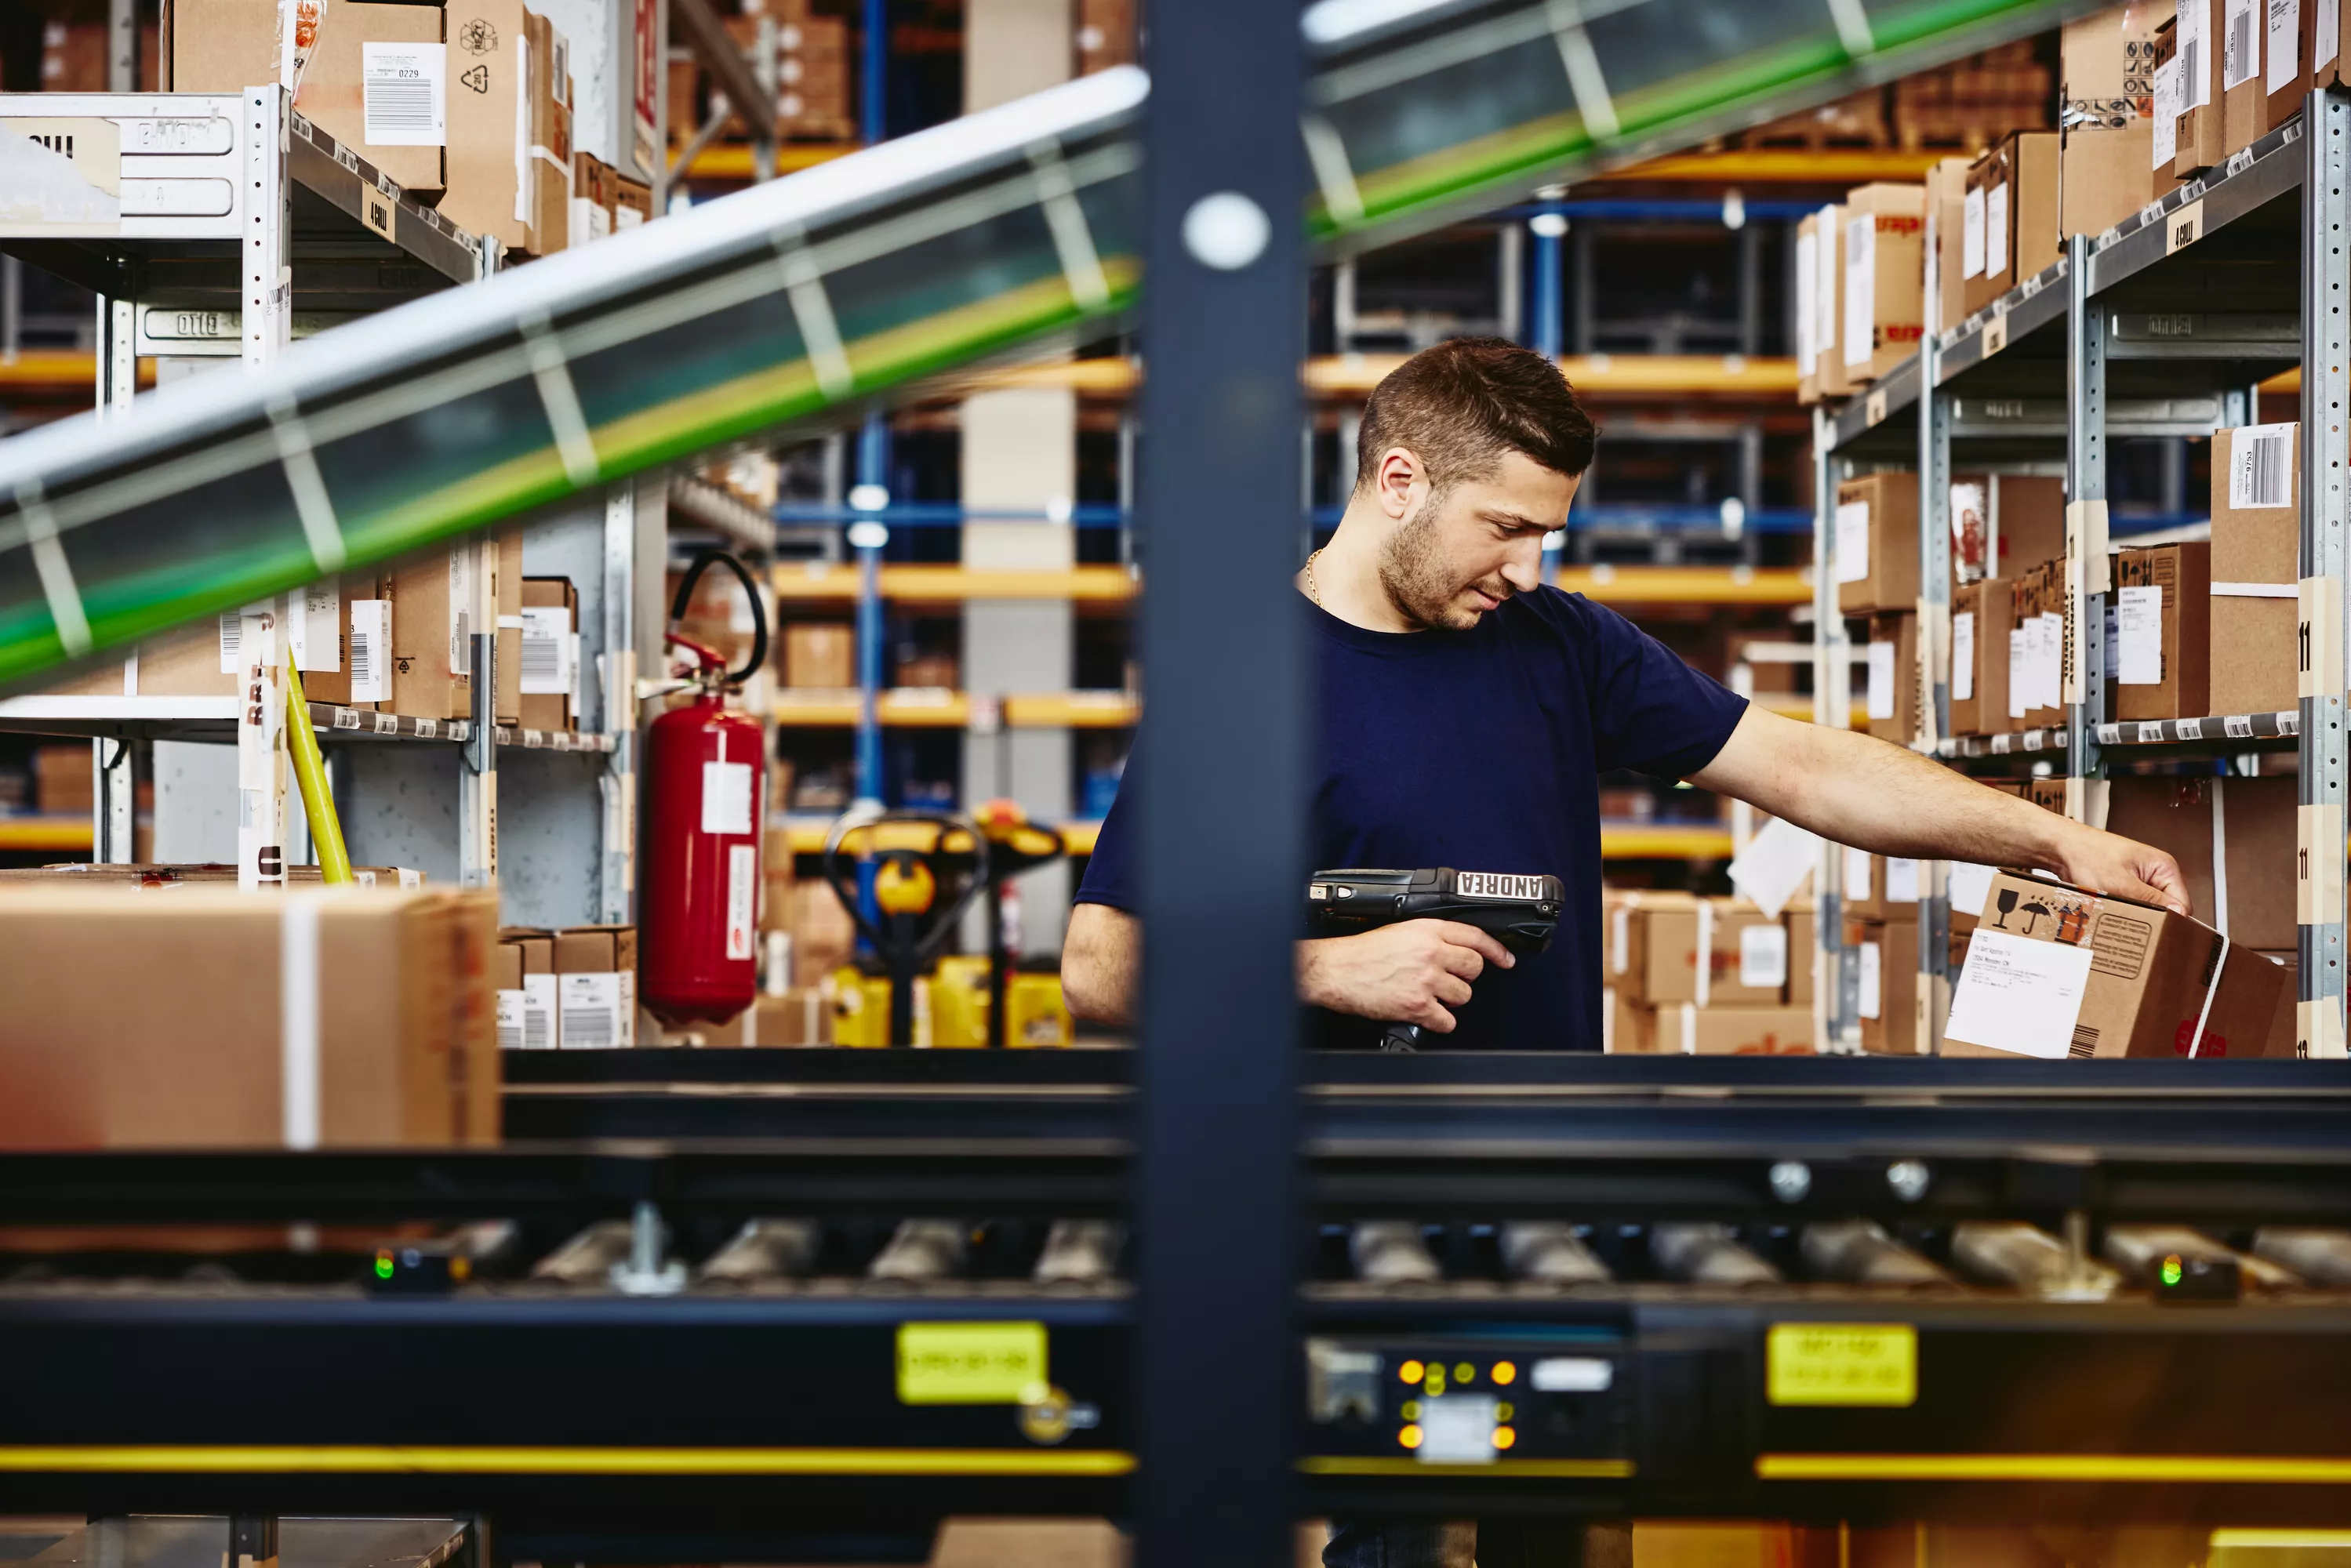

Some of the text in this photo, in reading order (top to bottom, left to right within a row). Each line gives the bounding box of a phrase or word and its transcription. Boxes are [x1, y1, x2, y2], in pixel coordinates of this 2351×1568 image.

[398, 69, 419, 78] 0229
[370, 201, 387, 232] 4 COLLI
[2175, 220, 2193, 249] 4 COLLI
[2299, 620, 2310, 672] 11
[2299, 848, 2308, 880] 11
[1462, 873, 1542, 898] ANDREA
